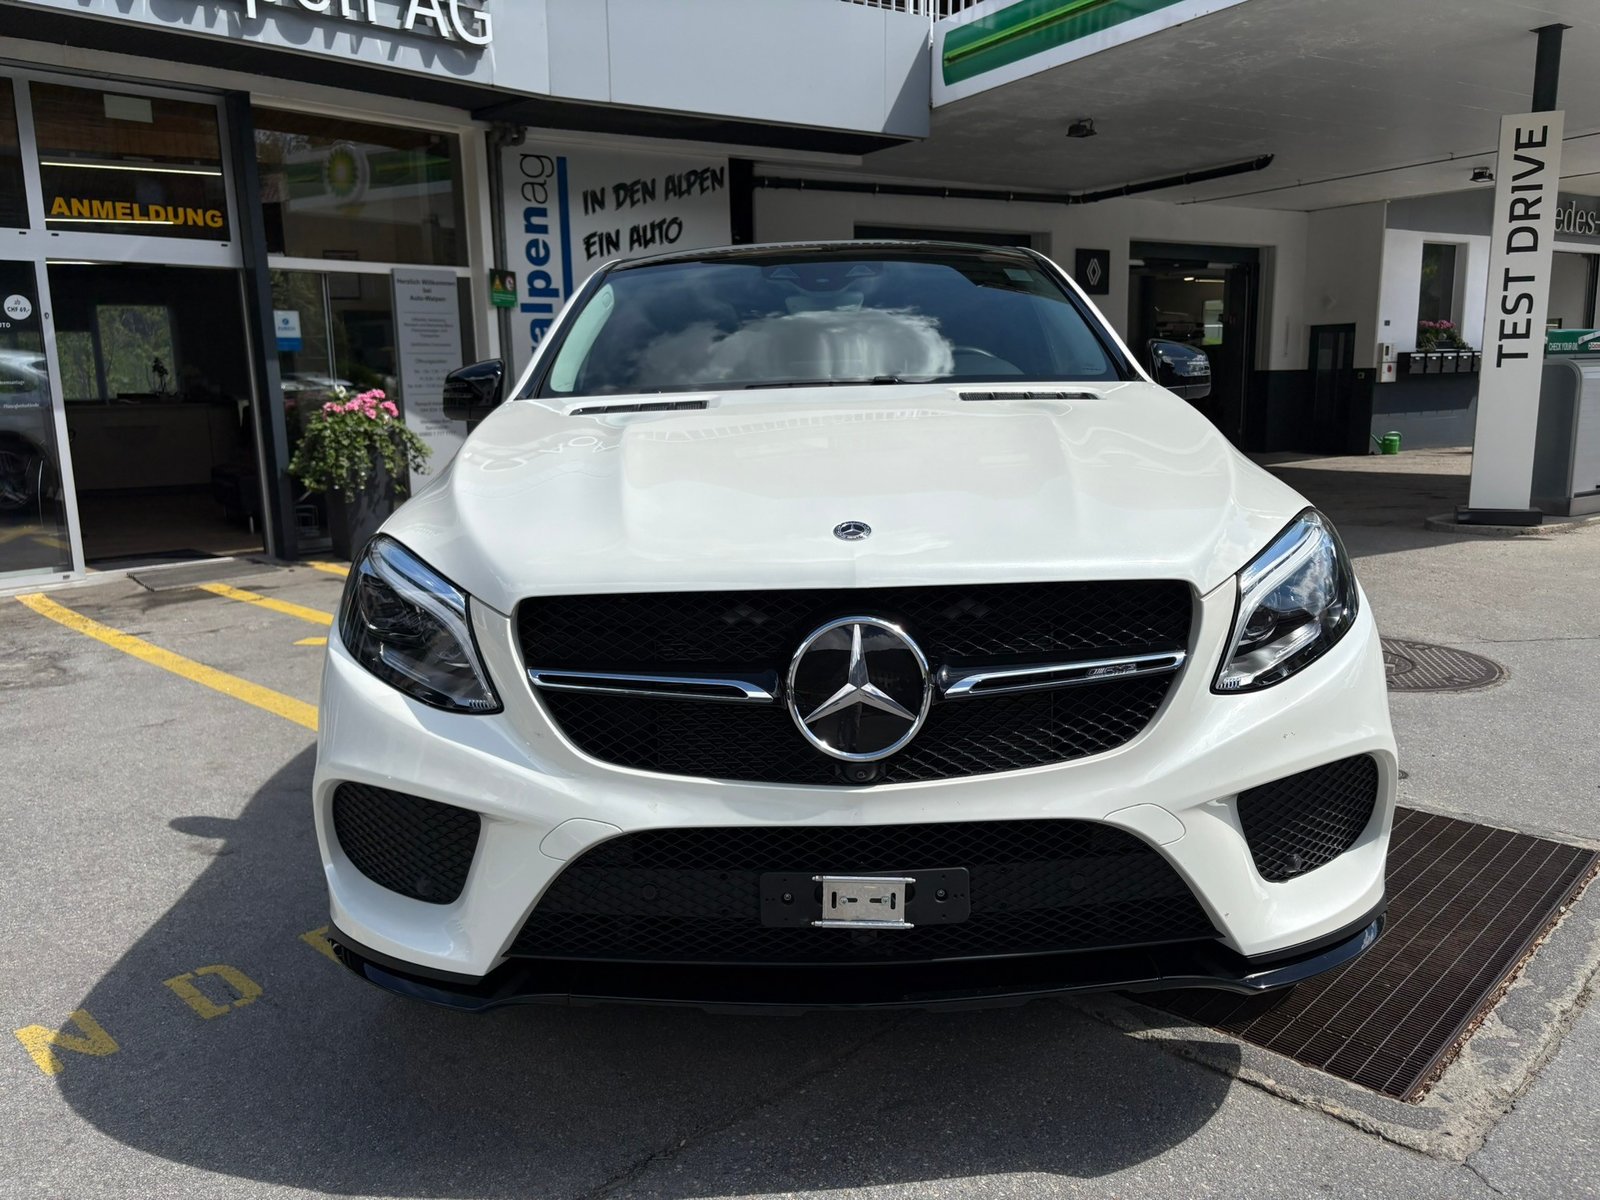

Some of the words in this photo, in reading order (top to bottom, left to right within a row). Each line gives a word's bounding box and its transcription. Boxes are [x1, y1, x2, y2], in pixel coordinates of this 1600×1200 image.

[404, 0, 493, 46] AG
[50, 196, 224, 229] ANMELDUNG
[582, 187, 606, 216] IN
[612, 178, 656, 211] DEN
[664, 166, 725, 201] ALPEN
[1506, 125, 1549, 255] DRIVE
[582, 229, 621, 262] EIN
[628, 216, 684, 253] AUTO
[1496, 267, 1536, 368] TEST
